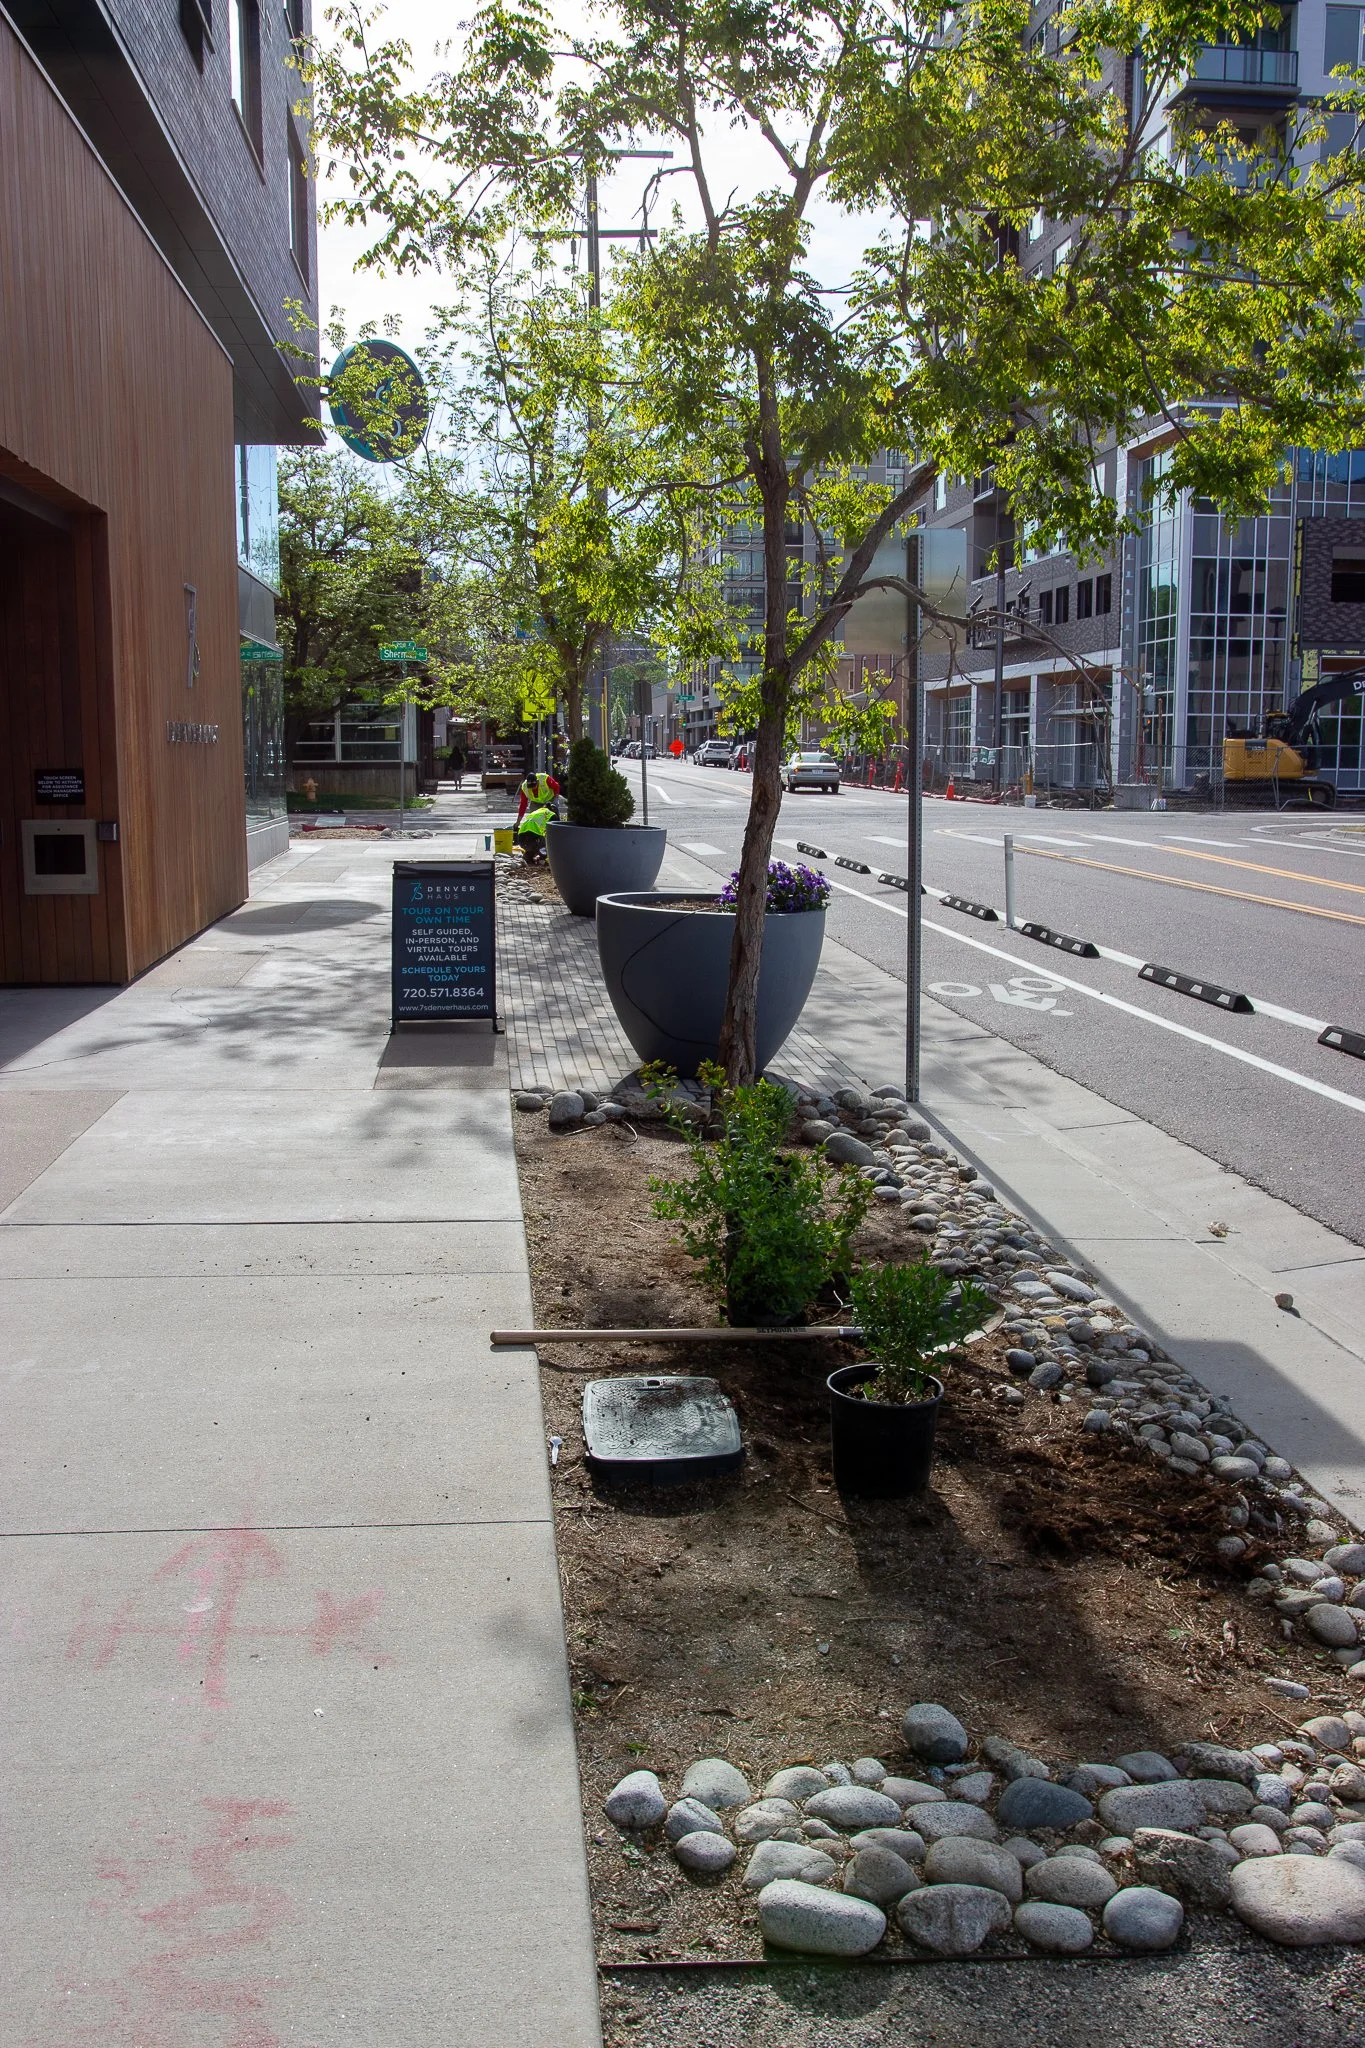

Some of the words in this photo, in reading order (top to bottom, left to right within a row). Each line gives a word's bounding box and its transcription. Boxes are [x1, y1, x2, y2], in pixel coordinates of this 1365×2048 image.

[427, 885, 476, 893] DENVER
[401, 907, 431, 915] TOUR
[454, 906, 484, 914] YOUR
[415, 916, 442, 924] OWN
[446, 915, 471, 923] TIME
[412, 928, 434, 936] SELF
[417, 954, 468, 962] AVAILABLE
[401, 966, 452, 974] SCHEDULE
[454, 965, 486, 973] YOURS
[428, 974, 460, 982] TODAY
[402, 987, 485, 998] 720.571.8364
